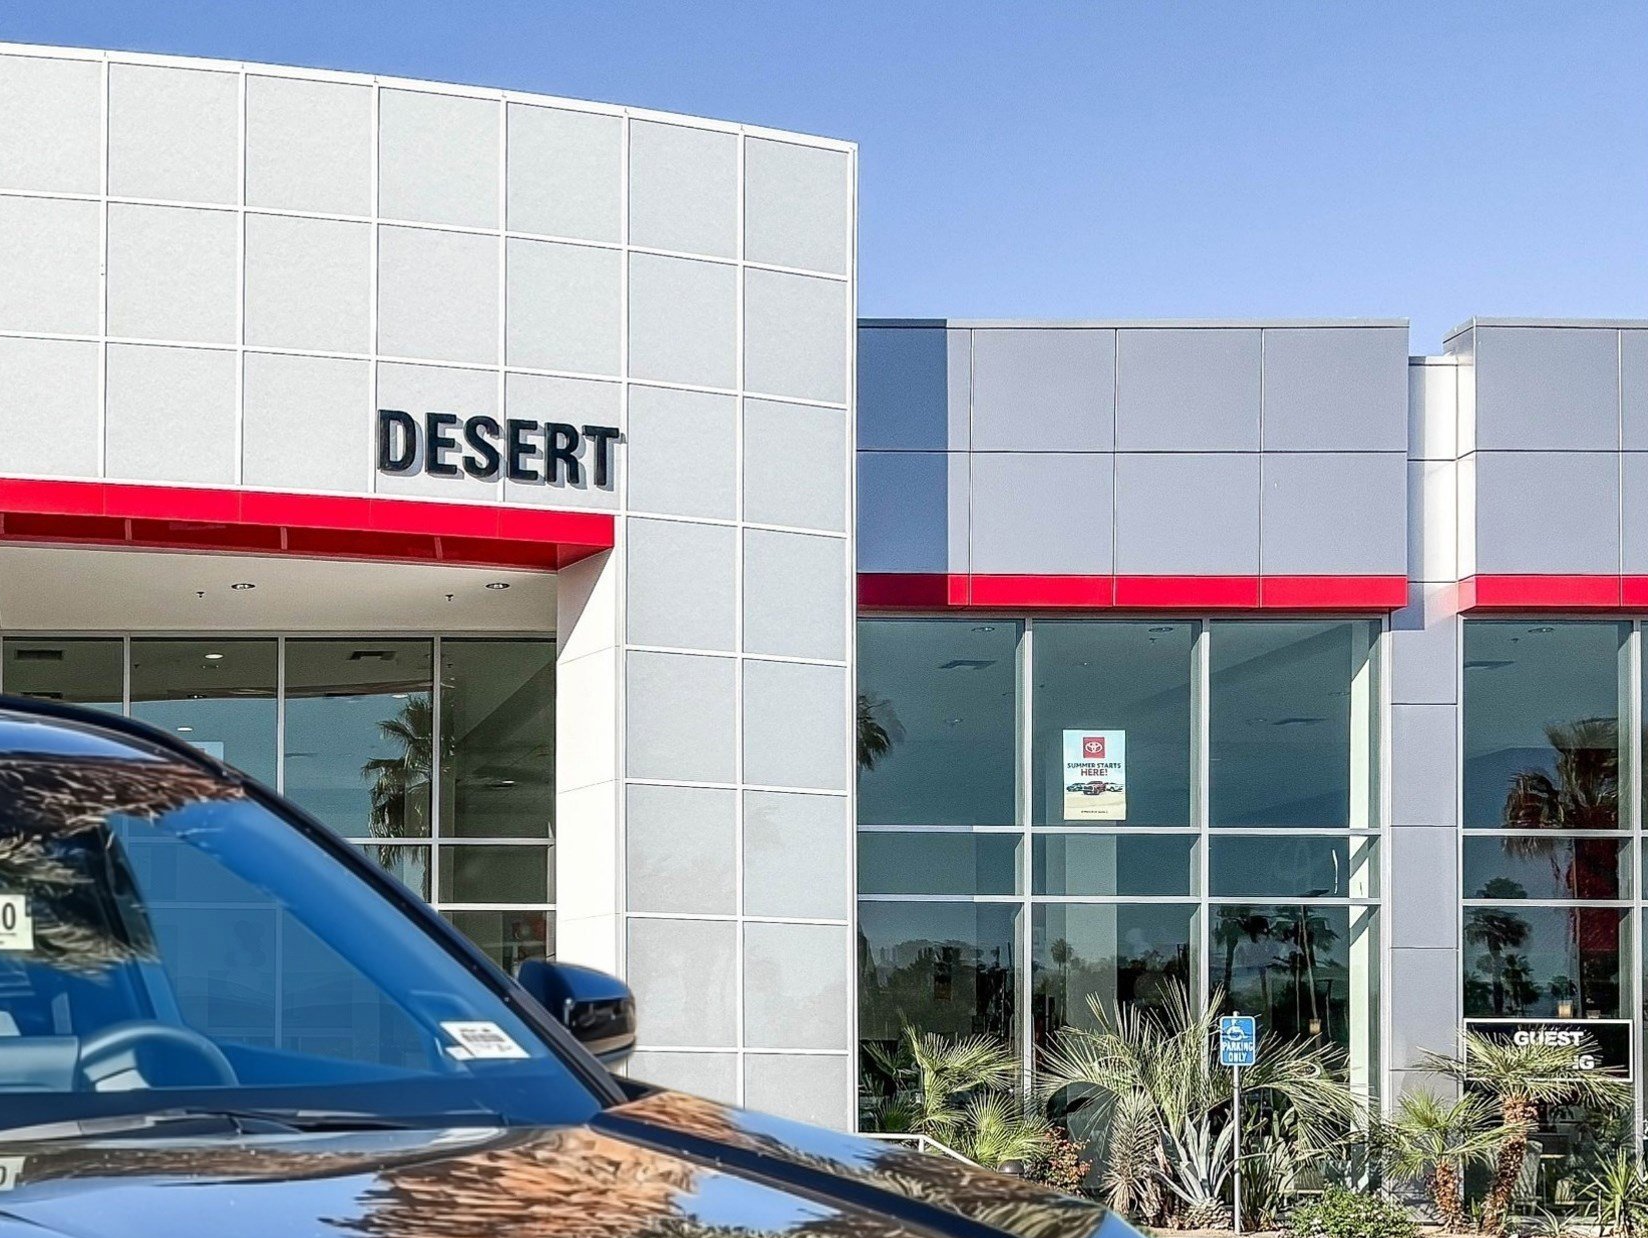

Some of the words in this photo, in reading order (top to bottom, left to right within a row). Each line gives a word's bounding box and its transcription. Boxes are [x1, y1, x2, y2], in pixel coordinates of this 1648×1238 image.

[376, 408, 621, 487] DESERT
[1080, 768, 1108, 776] HERE!
[1513, 1030, 1584, 1047] GUEST
[1221, 1041, 1254, 1052] PARKING
[1228, 1052, 1248, 1062] ONLY
